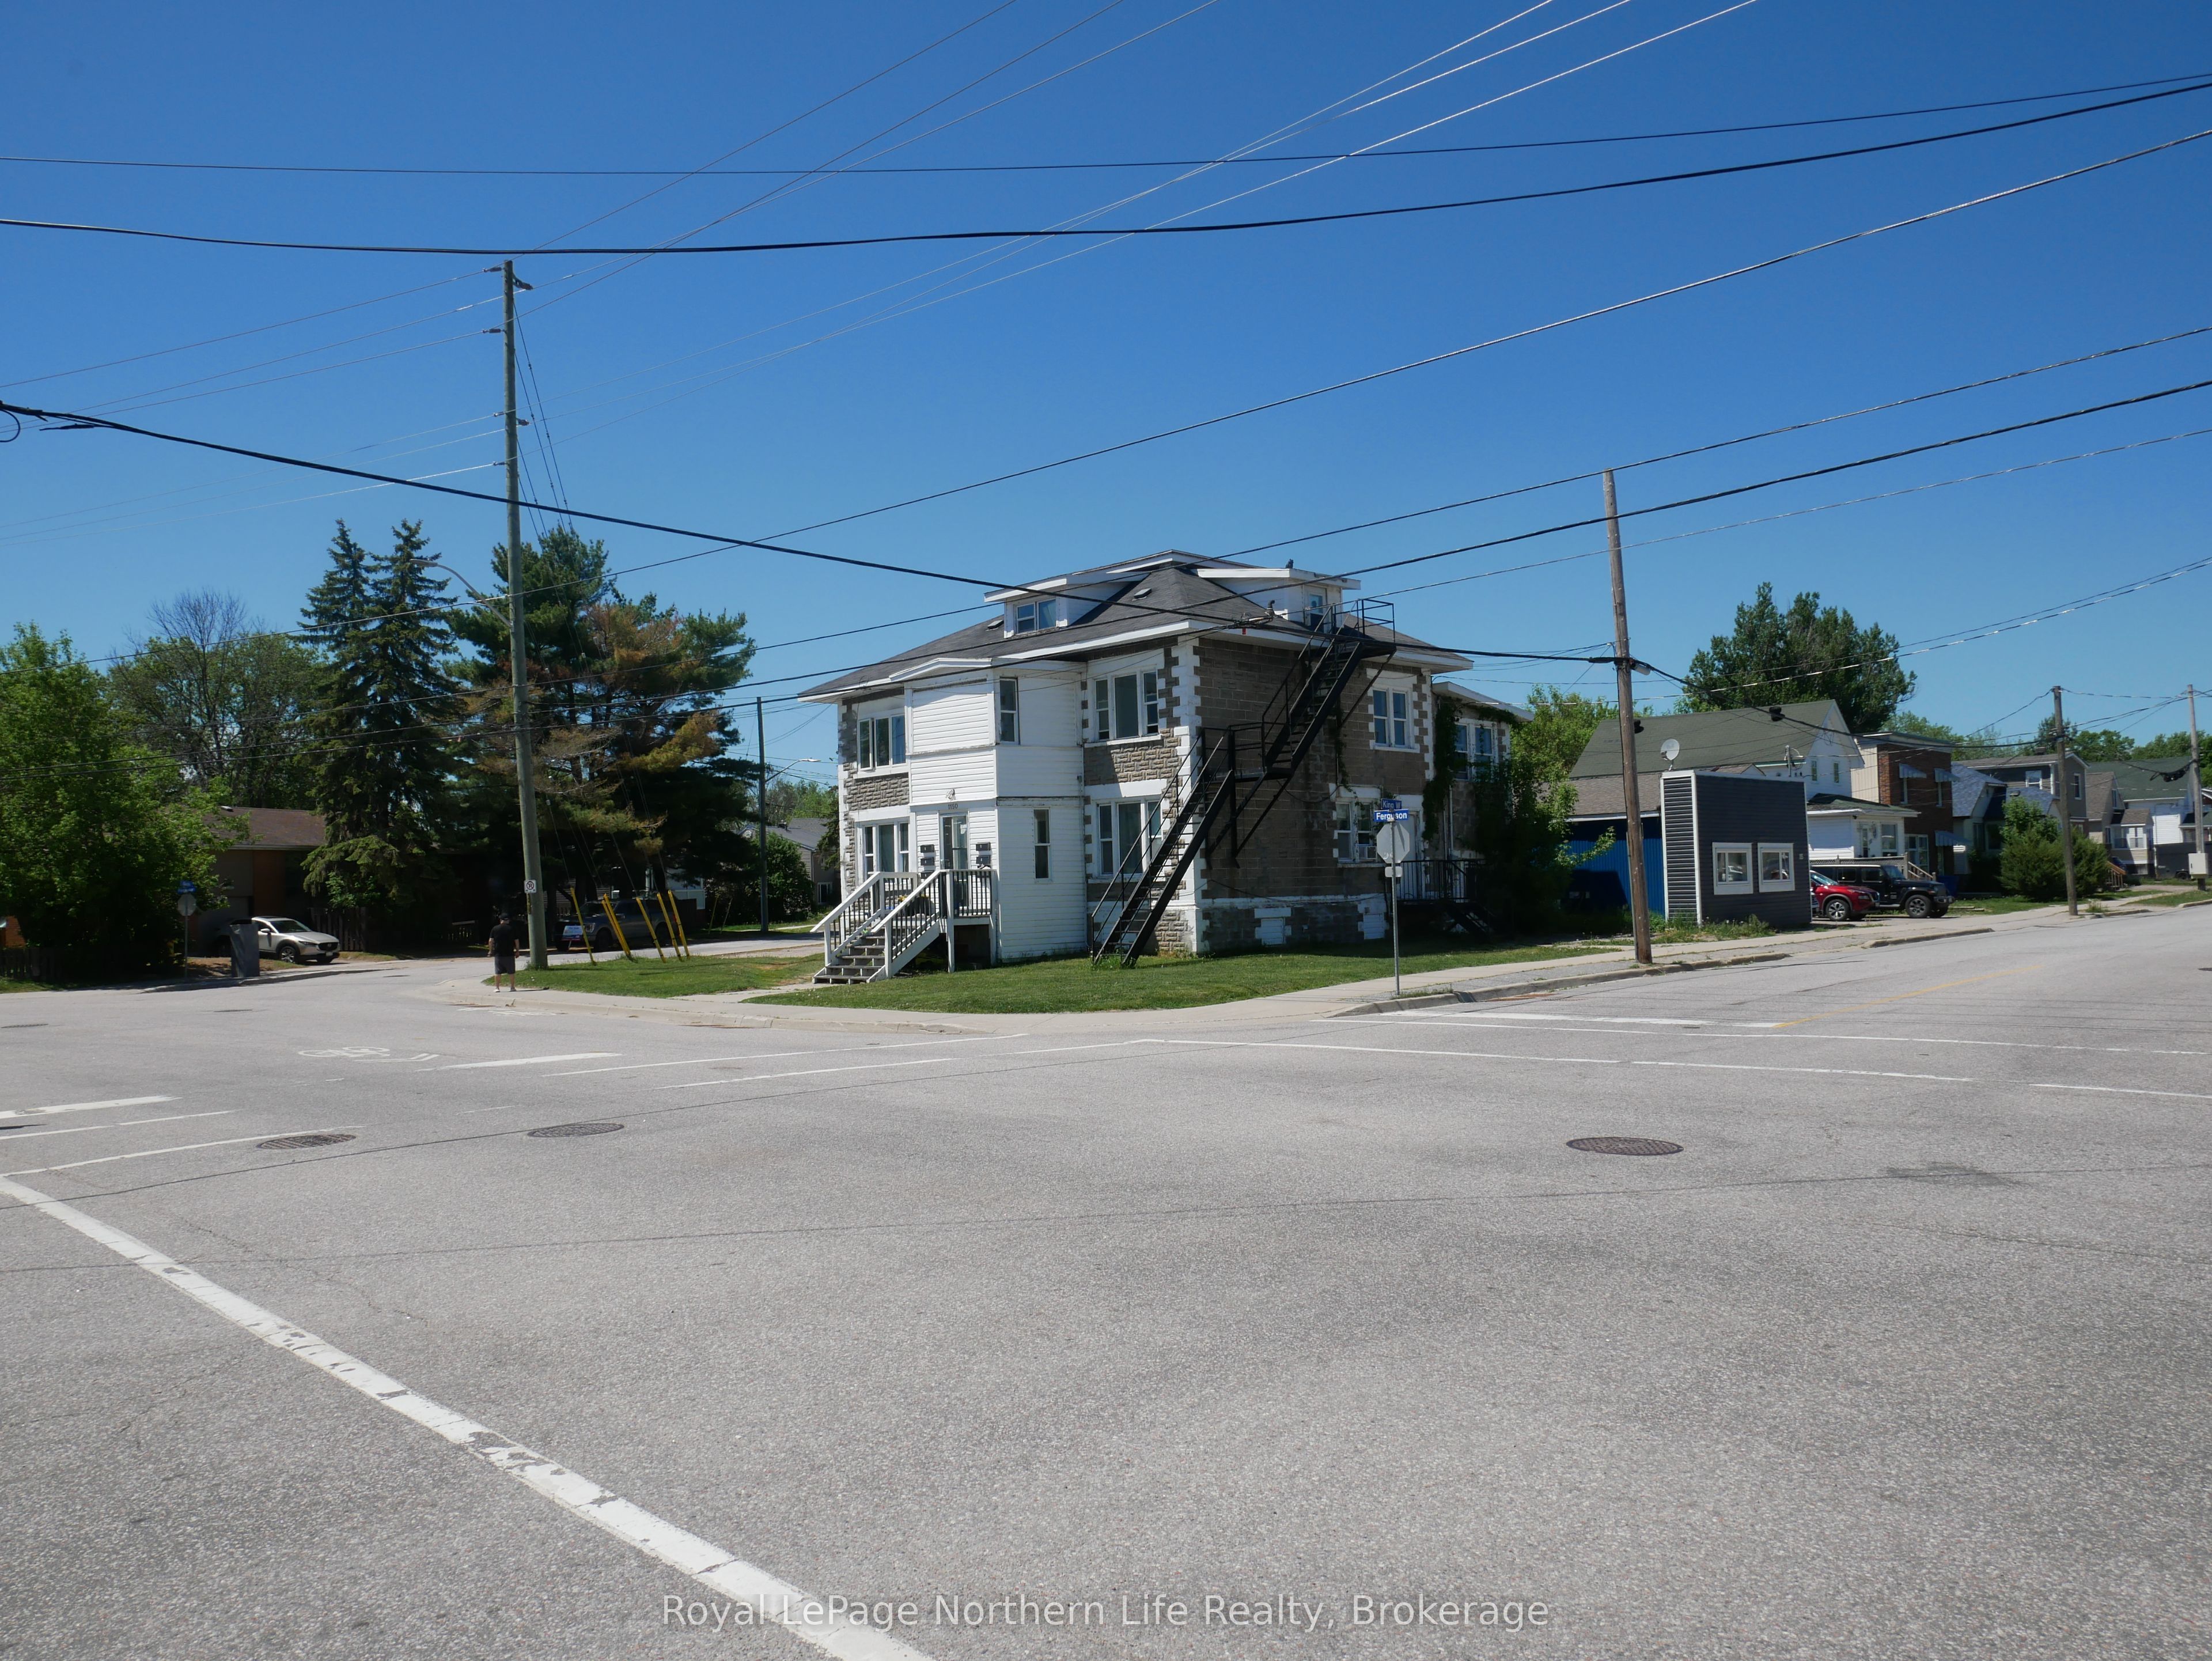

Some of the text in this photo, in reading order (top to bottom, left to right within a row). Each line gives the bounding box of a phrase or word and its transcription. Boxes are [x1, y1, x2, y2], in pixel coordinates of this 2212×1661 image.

[1382, 800, 1401, 809] King W
[1376, 812, 1407, 820] Ferguson
